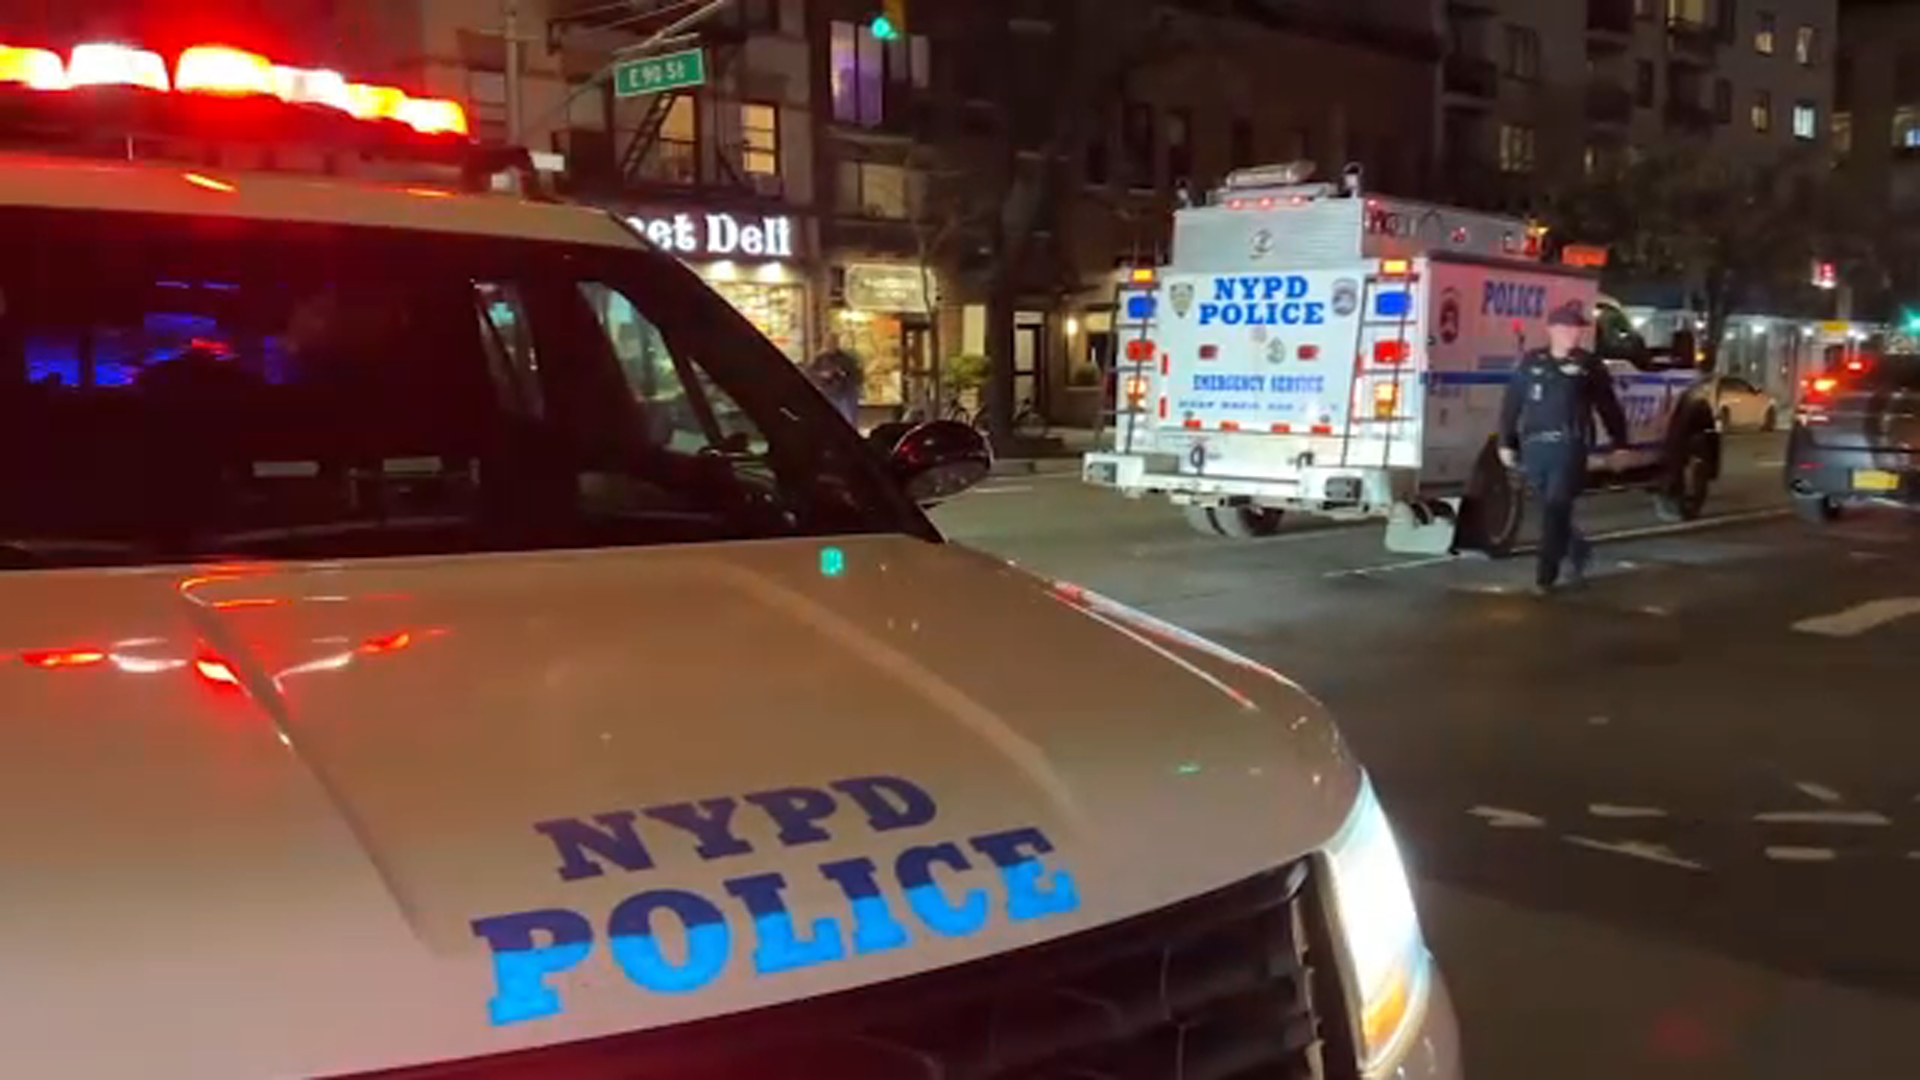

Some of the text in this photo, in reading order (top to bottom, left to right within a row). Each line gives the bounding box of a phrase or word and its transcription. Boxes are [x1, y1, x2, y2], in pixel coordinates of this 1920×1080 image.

[629, 60, 685, 88] E 90 St
[705, 213, 792, 256] Deli
[1213, 275, 1309, 301] NYPD
[1481, 280, 1547, 318] POLICE
[1199, 302, 1325, 326] POLICE
[1193, 374, 1325, 393] EMERGENCY SERVICE
[534, 775, 938, 882] NYPD
[470, 827, 1080, 1026] POLICE
